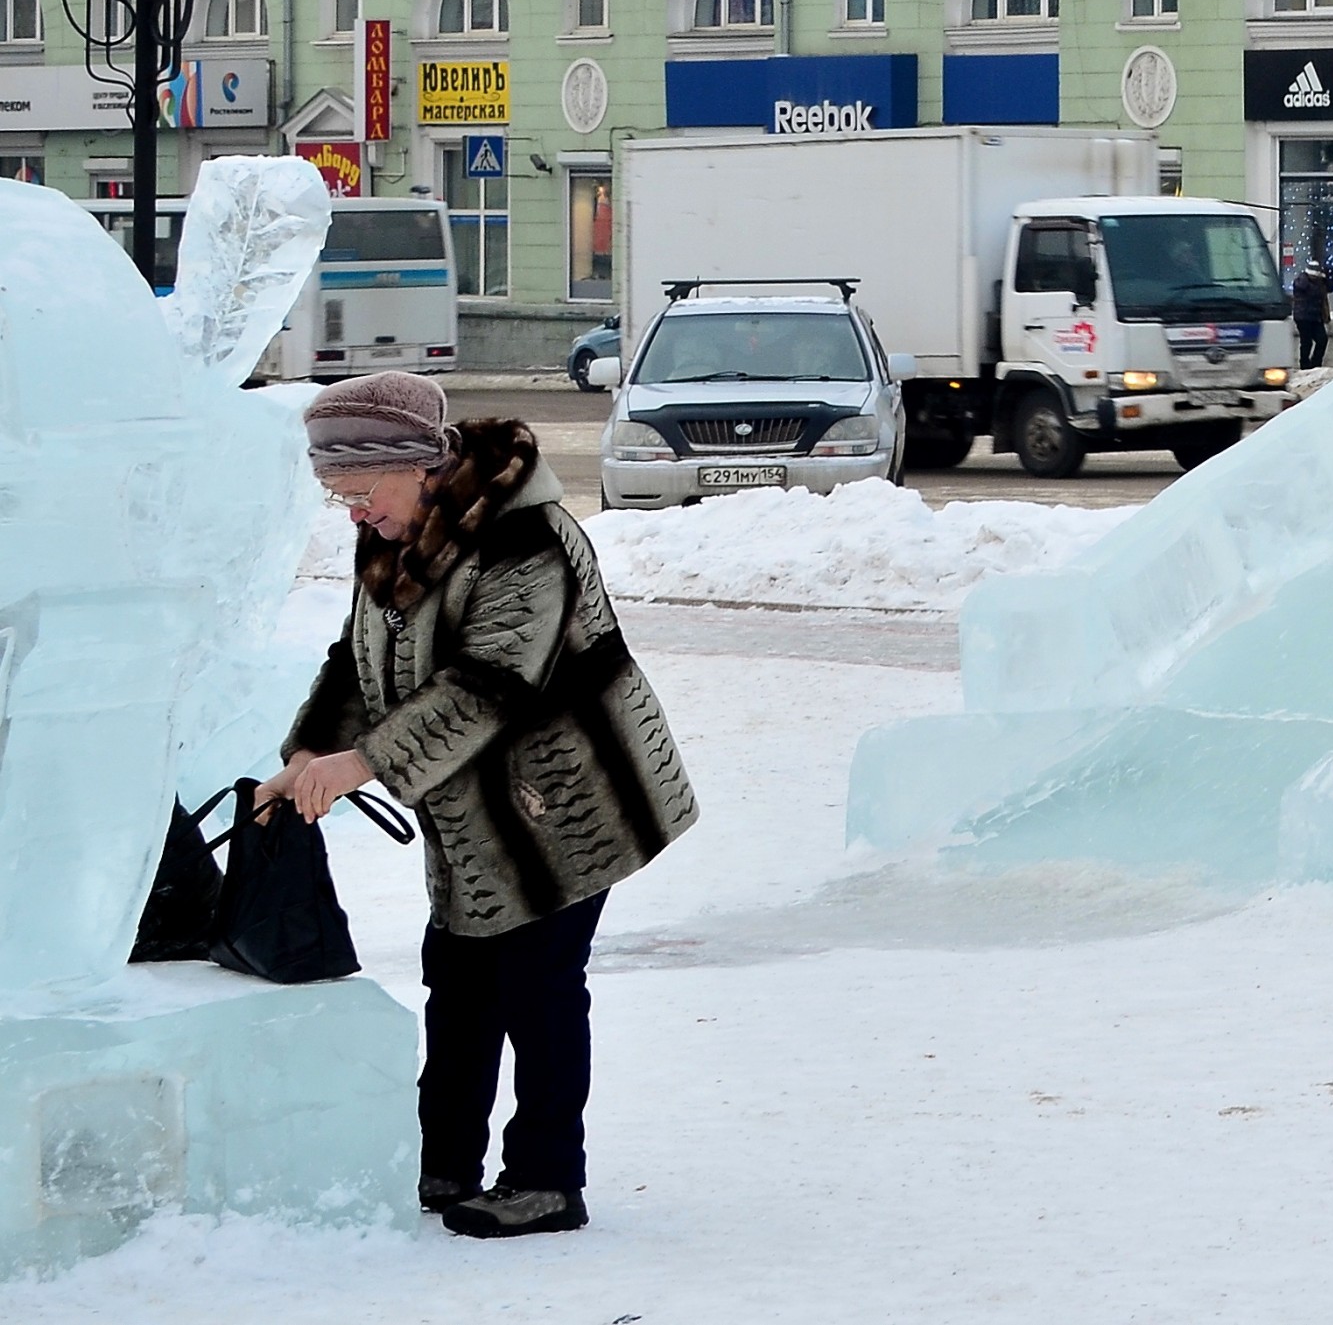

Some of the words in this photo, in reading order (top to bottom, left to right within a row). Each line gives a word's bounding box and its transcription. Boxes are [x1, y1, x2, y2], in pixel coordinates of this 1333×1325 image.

[366, 22, 387, 139] ЛОМБАРД
[422, 103, 506, 121] мастерская
[1283, 90, 1331, 108] adidas
[774, 99, 873, 133] Reebok
